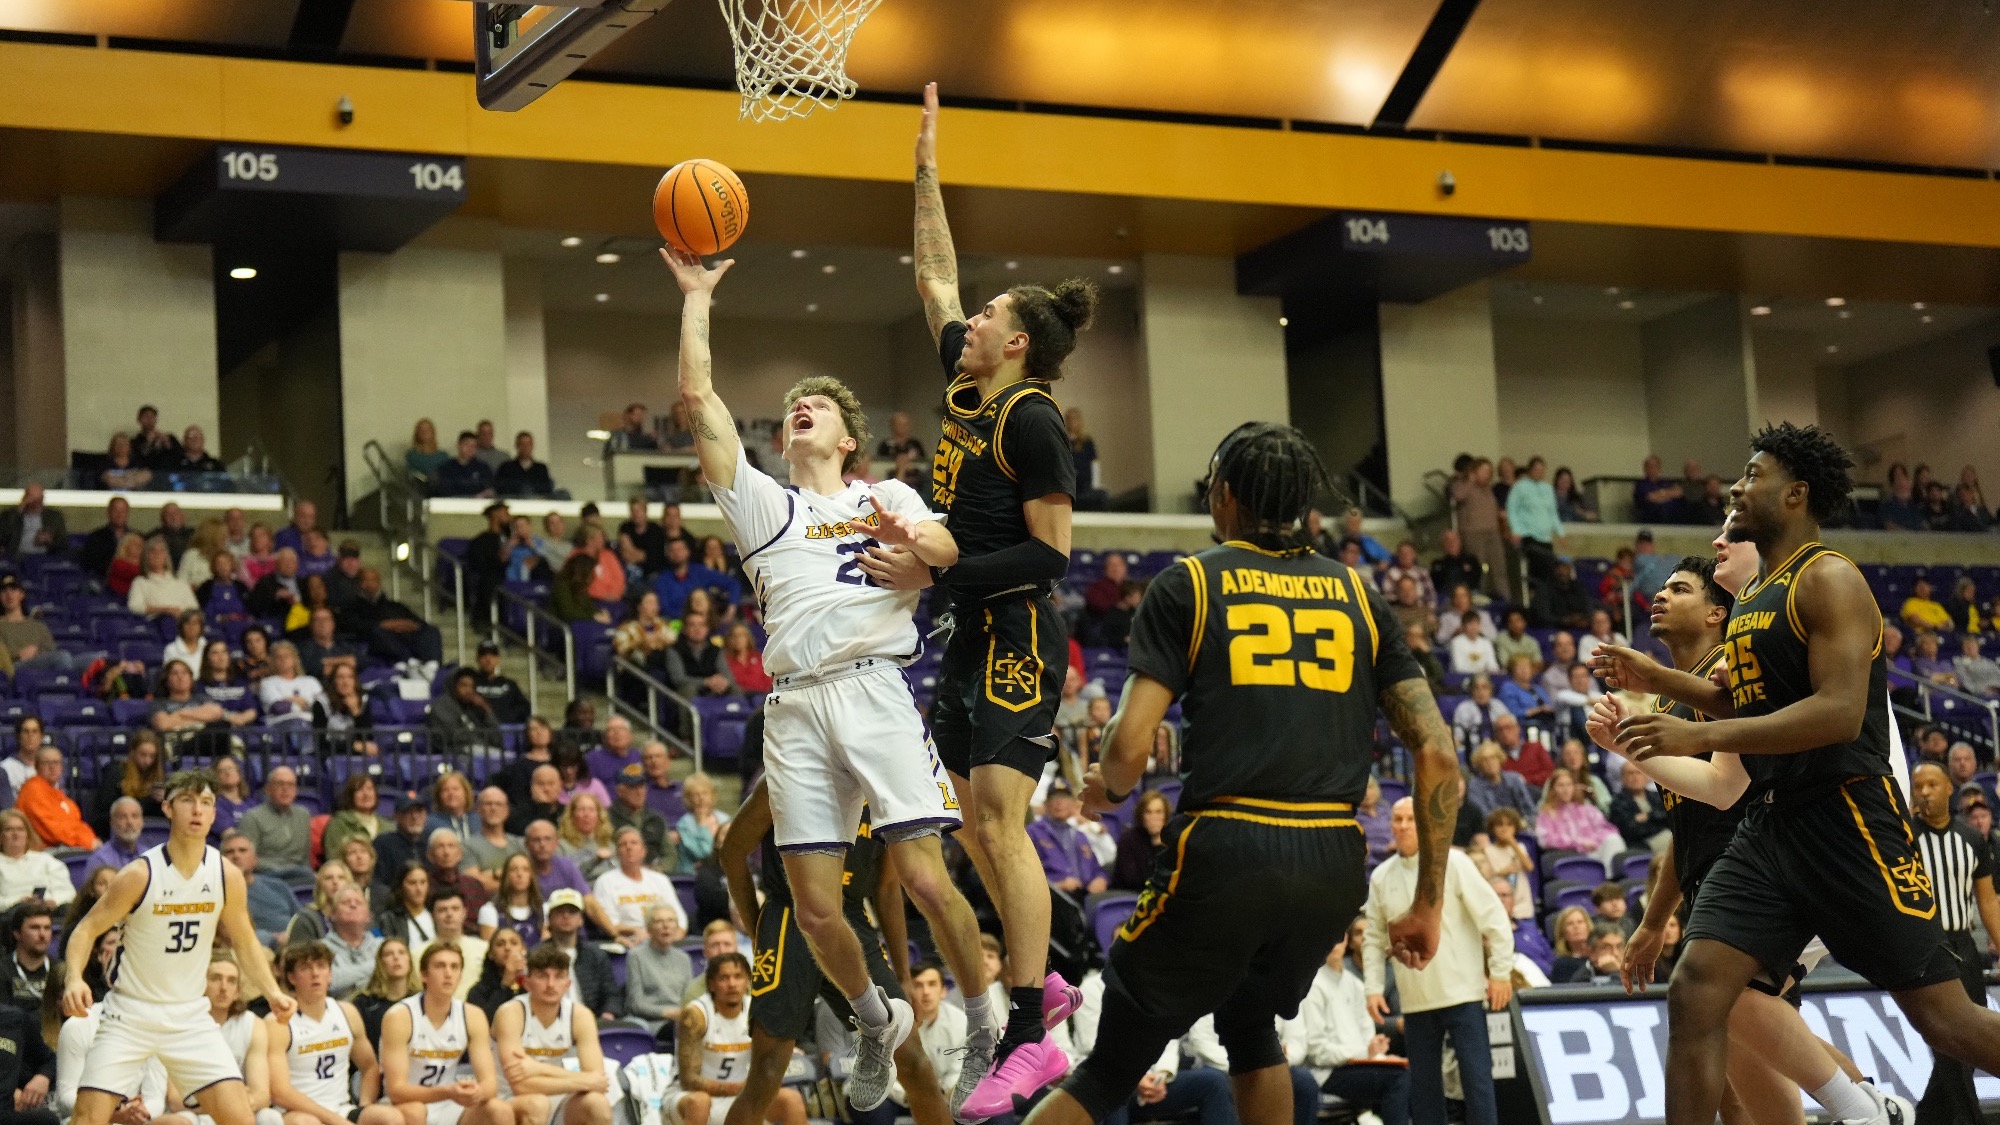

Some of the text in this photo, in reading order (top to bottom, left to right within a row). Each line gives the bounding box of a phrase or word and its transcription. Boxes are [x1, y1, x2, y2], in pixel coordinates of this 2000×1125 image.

[223, 151, 279, 181] 105
[409, 163, 464, 192] 104
[711, 179, 738, 241] Wilson
[1345, 218, 1389, 244] 104
[1487, 227, 1529, 252] 103
[933, 438, 965, 491] 24
[1221, 568, 1349, 603] ADEMOKOYA
[1226, 603, 1355, 693] 23
[1724, 634, 1762, 689] 25
[936, 781, 960, 811] L
[165, 921, 200, 953] 35
[315, 1054, 336, 1080] 12
[419, 1065, 446, 1088] 21
[717, 1057, 735, 1080] 5
